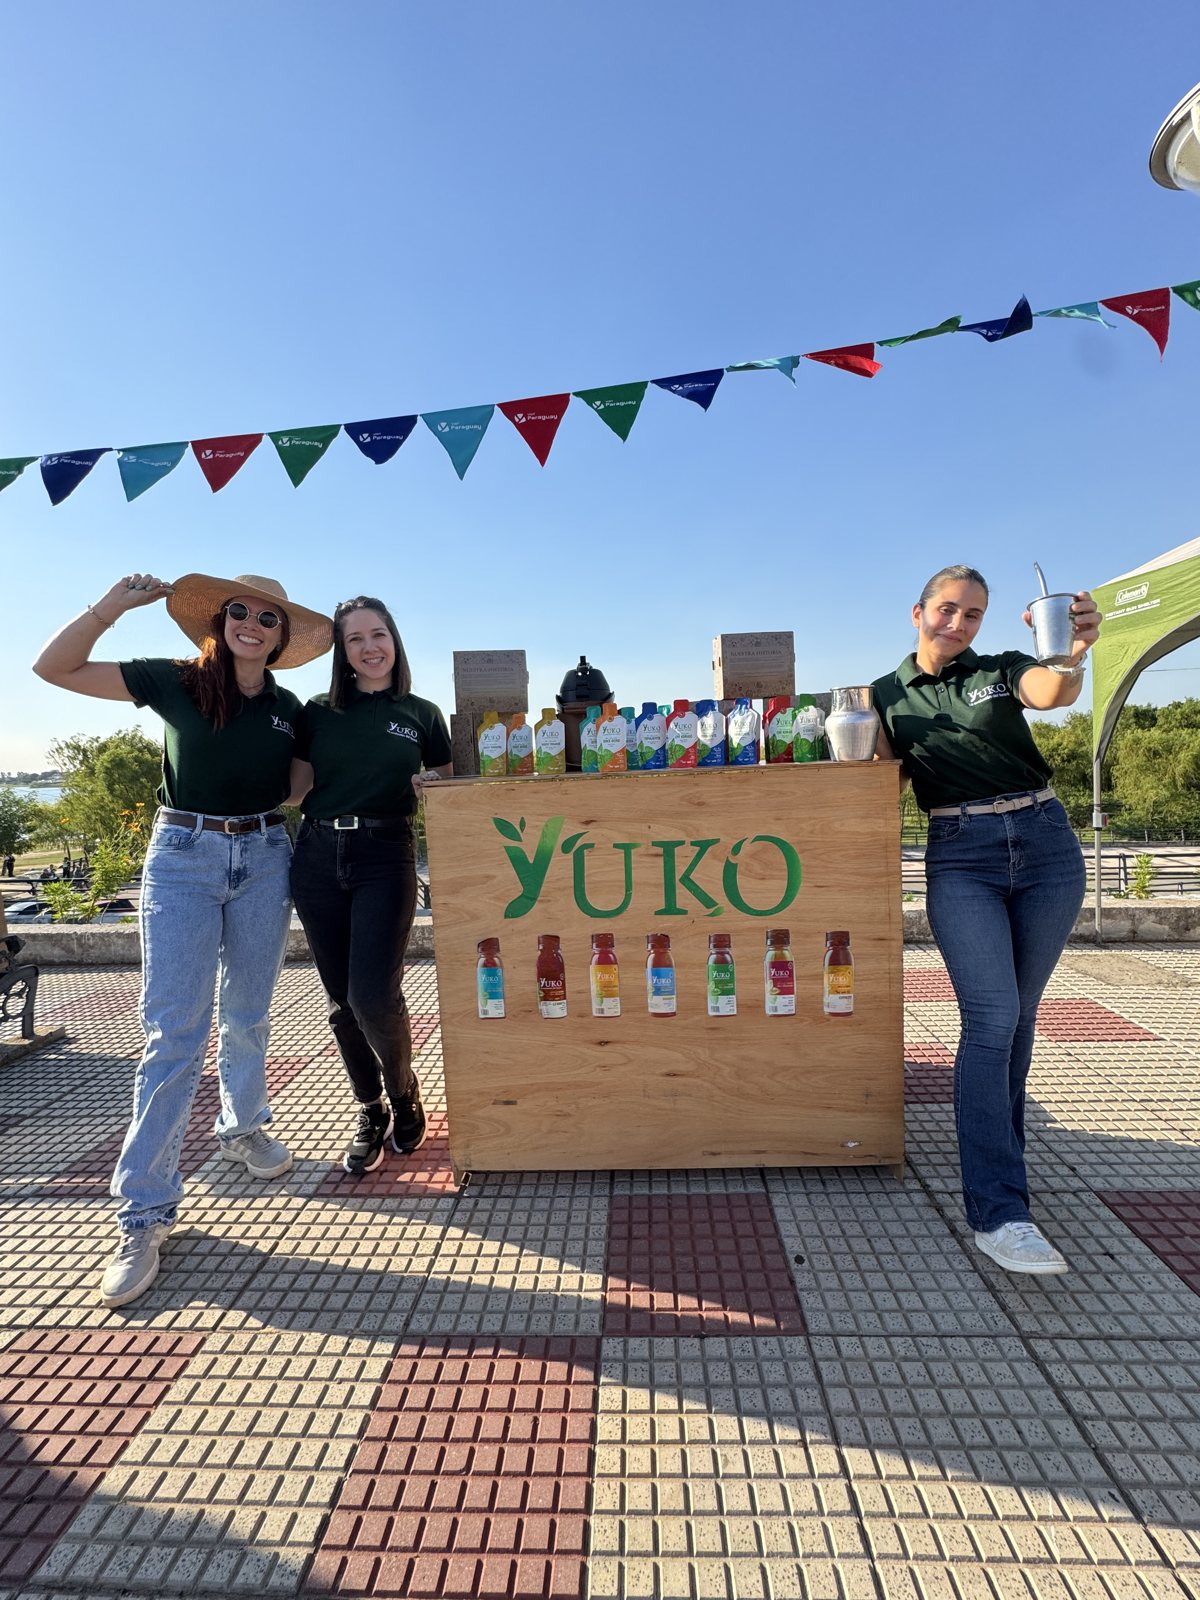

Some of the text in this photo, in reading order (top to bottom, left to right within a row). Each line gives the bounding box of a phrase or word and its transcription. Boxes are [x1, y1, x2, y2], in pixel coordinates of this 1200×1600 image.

[527, 413, 558, 421] Paraguay
[450, 423, 482, 431] Paraguay
[372, 433, 403, 441] Paraguay
[291, 439, 323, 449] Paraguay
[214, 450, 244, 459] Paraguay
[60, 457, 93, 467] Paraguay
[967, 683, 1006, 703] YUKO
[389, 721, 418, 738] YUKO
[541, 729, 560, 737] YUKO
[602, 726, 620, 734] YUKO
[491, 815, 803, 919] YUKO
[712, 970, 731, 978] YUKO
[770, 967, 790, 977] YUKO
[540, 977, 563, 988] YUKO
[652, 975, 672, 984] YUKO
